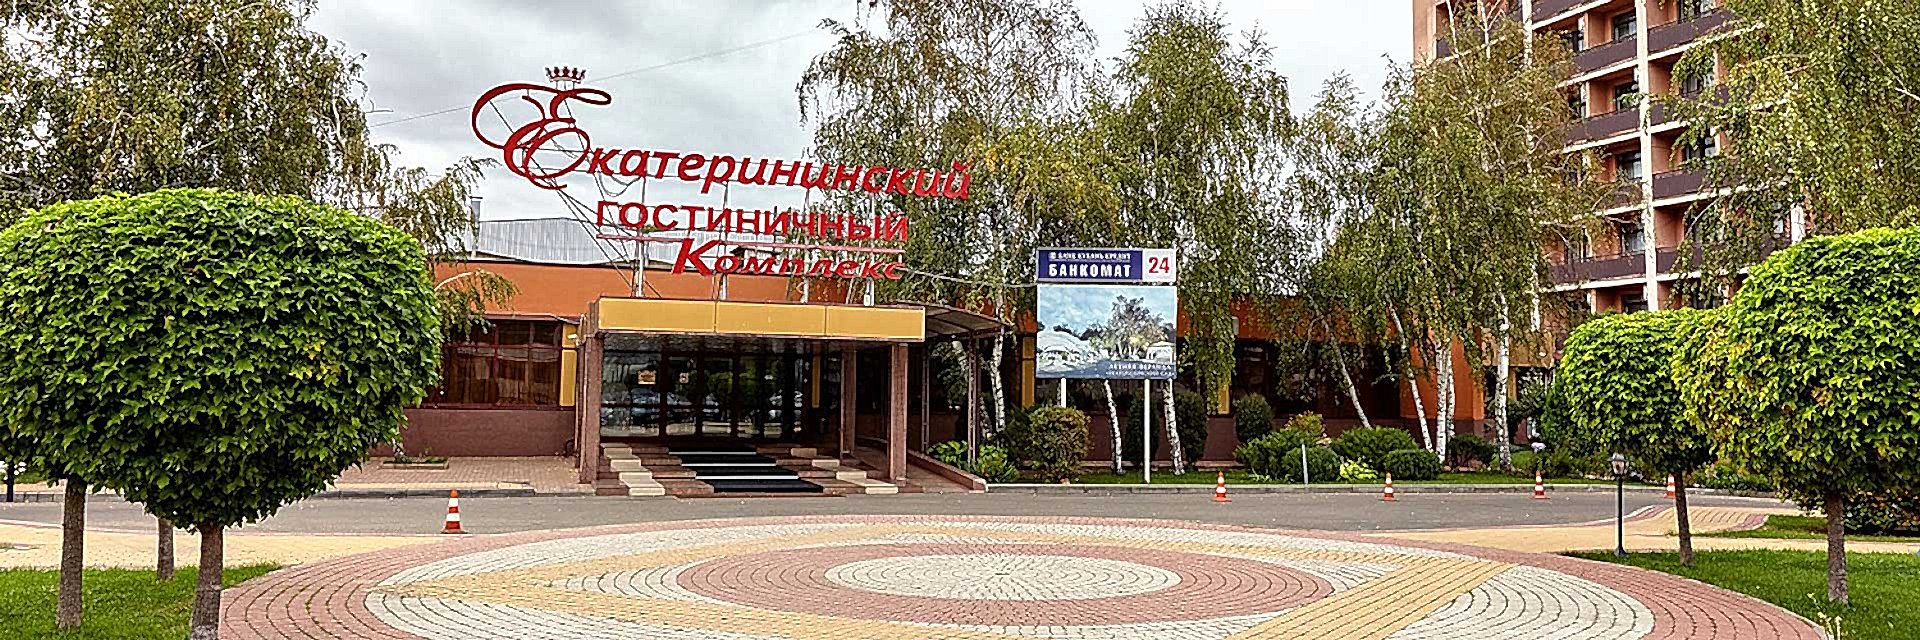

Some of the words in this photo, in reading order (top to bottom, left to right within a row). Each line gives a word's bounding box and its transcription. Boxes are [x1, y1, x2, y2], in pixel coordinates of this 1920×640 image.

[472, 83, 973, 200] Екатерининский
[1048, 264, 1131, 278] БАНКОМАТ
[1148, 256, 1170, 274] 24
